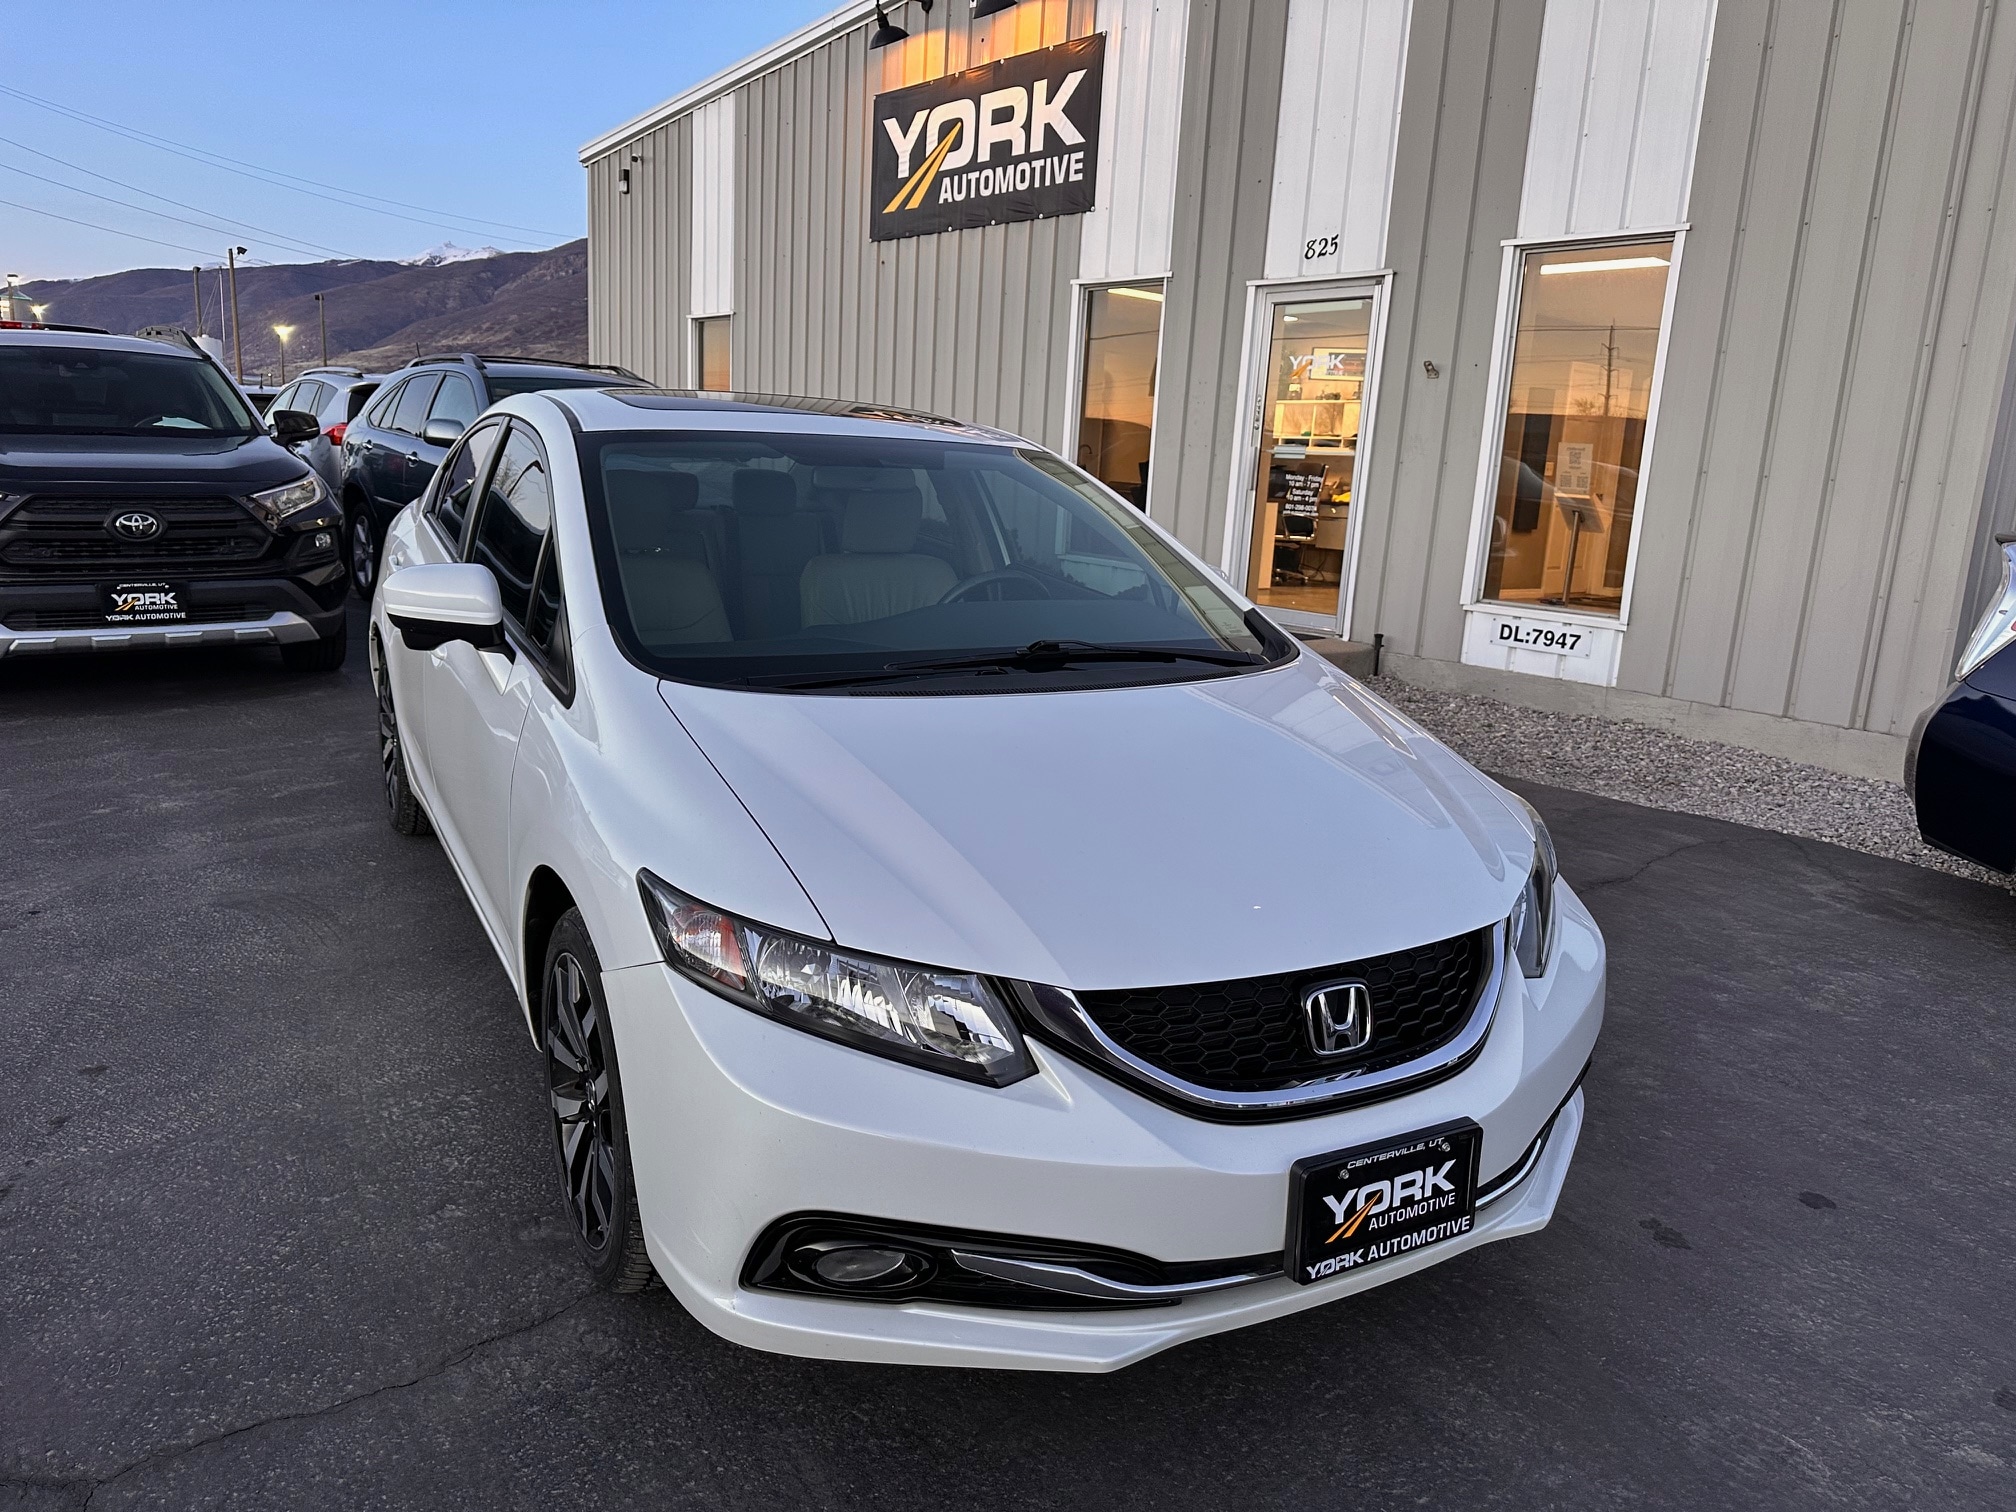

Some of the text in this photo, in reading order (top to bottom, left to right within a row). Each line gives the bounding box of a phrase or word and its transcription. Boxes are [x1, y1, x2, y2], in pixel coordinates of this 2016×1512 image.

[882, 68, 1087, 178] YORK
[938, 151, 1084, 204] AUTOMOTIVE
[1304, 233, 1339, 260] 825
[1285, 474, 1305, 482] Monday
[1292, 488, 1314, 496] Saturday
[110, 592, 177, 606] YORK
[135, 612, 186, 620] AUTOMOTIVE
[1499, 624, 1582, 650] DL:7947
[1347, 1137, 1445, 1169] CENTERVILLE, UT
[1322, 1158, 1457, 1225] YORK
[1368, 1192, 1456, 1231] AUTOMOTIVE
[1306, 1215, 1471, 1279] YORK AUTOMOTIVE
